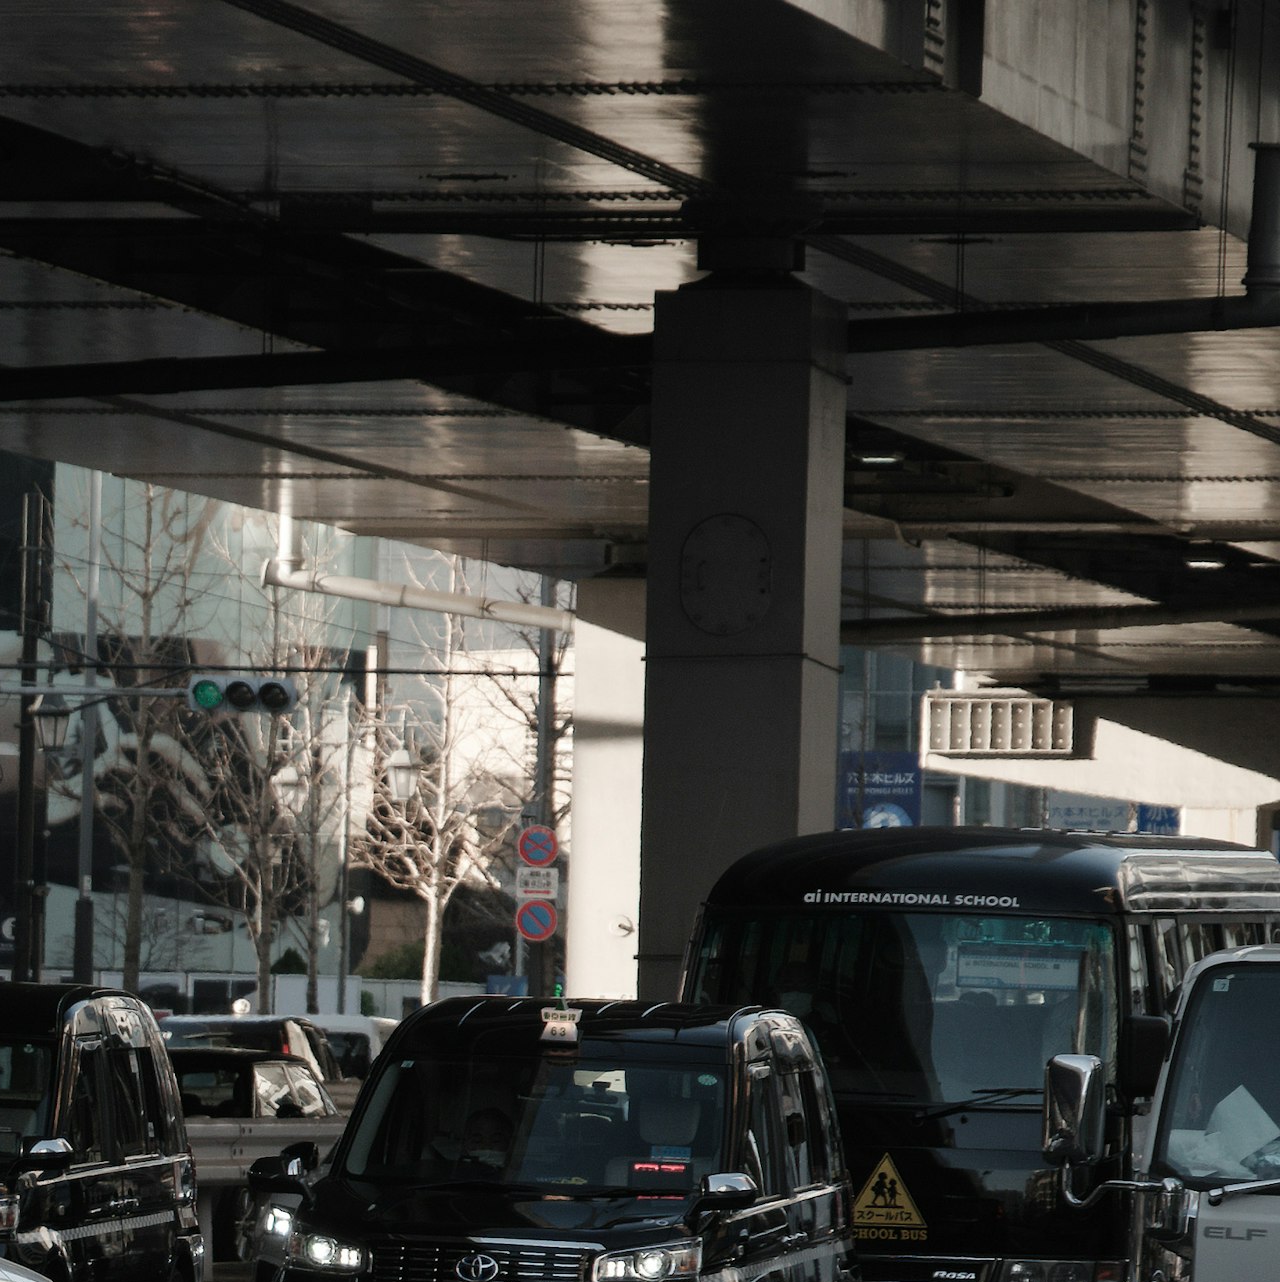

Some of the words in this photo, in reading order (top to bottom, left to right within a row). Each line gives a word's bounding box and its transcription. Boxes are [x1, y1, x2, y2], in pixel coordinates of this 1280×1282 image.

[803, 888, 822, 904] ai
[824, 892, 950, 906] INTERNATIONAL
[954, 894, 1020, 908] SCHOOL
[550, 1026, 566, 1037] 63
[856, 1210, 913, 1221] スクールバス
[851, 1228, 898, 1240] CHOOL
[901, 1229, 928, 1240] BUS
[1203, 1226, 1268, 1241] ELF
